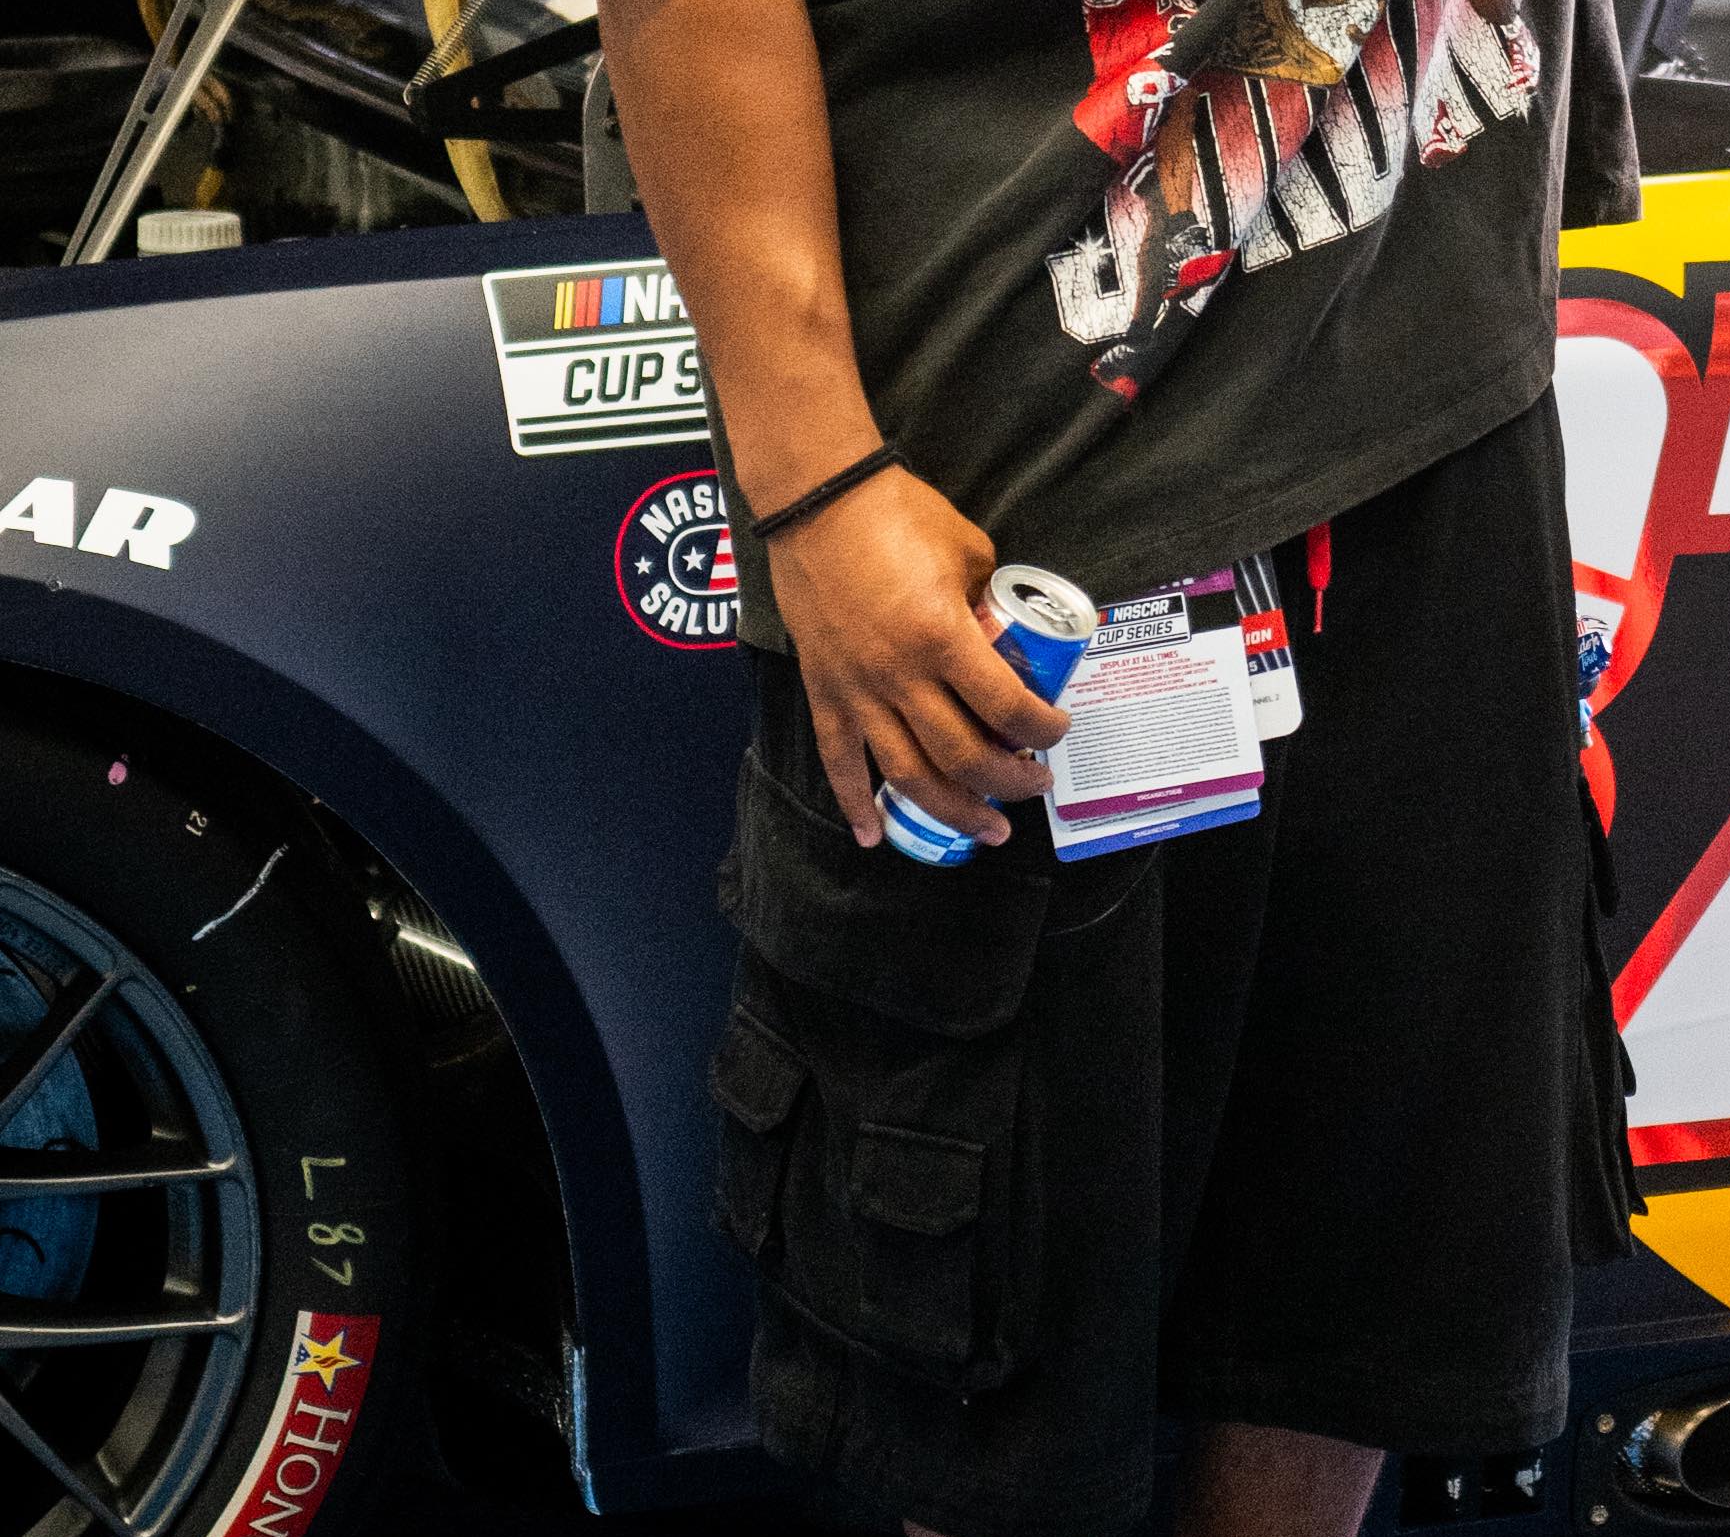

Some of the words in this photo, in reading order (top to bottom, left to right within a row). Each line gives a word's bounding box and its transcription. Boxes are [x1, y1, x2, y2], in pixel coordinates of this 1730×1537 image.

[563, 351, 664, 407] CUP
[1113, 599, 1170, 623] NASCAR
[1097, 628, 1124, 645] CUP
[1126, 620, 1173, 641] SERIES
[1100, 656, 1130, 671] DISPLAY
[1131, 655, 1140, 665] AT
[1141, 653, 1155, 664] ALL
[1156, 650, 1179, 662] TIMES
[300, 1155, 347, 1201] L
[308, 1222, 367, 1287] 87
